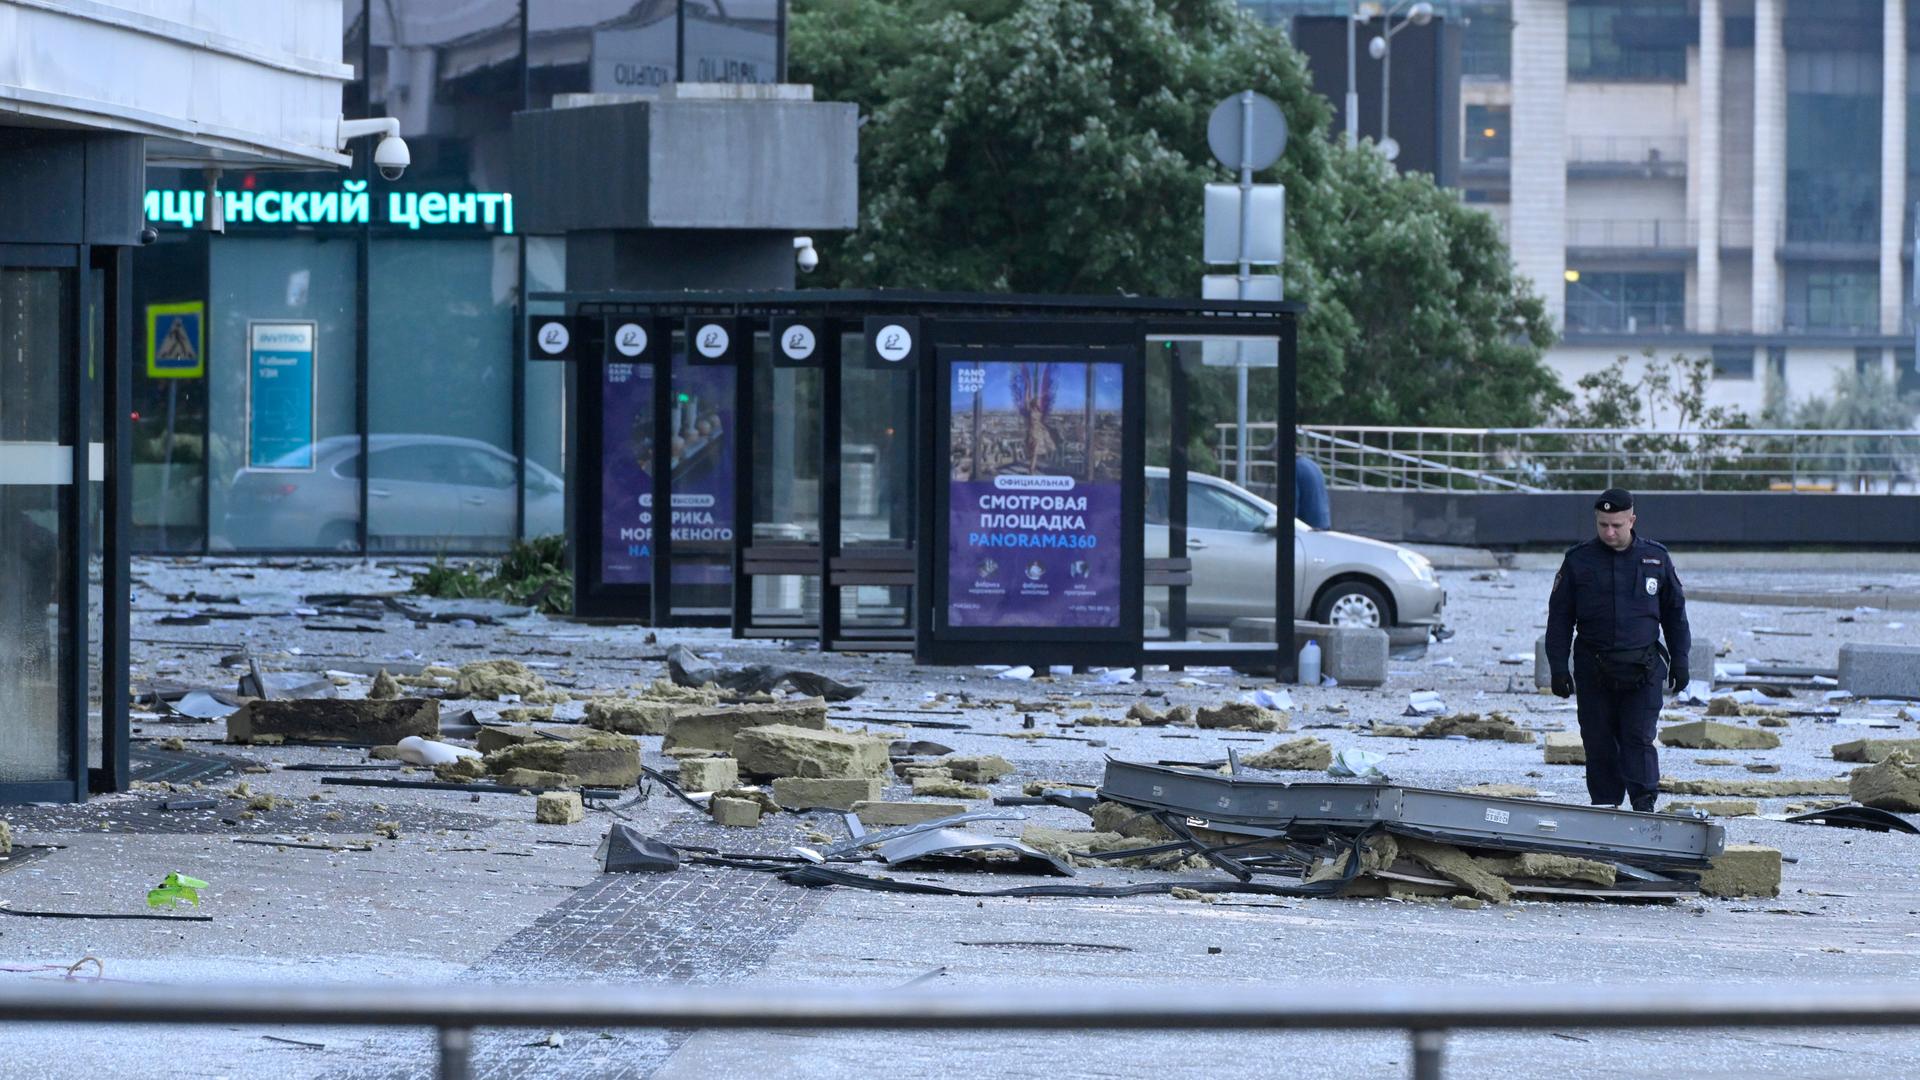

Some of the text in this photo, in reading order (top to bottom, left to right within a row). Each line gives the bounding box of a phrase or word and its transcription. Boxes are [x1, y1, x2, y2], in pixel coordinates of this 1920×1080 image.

[389, 191, 513, 233] цент
[958, 368, 985, 376] PANO
[958, 376, 985, 384] RAMA
[999, 477, 1070, 488] ОФИЦИАЛЬНАЯ
[979, 494, 1087, 511] СМОТРОВАЯ
[639, 511, 714, 525] ФРИКА
[980, 514, 1086, 530] ПЛОЩАДКА
[969, 532, 1097, 549] PANORAMA360
[628, 544, 651, 557] НА
